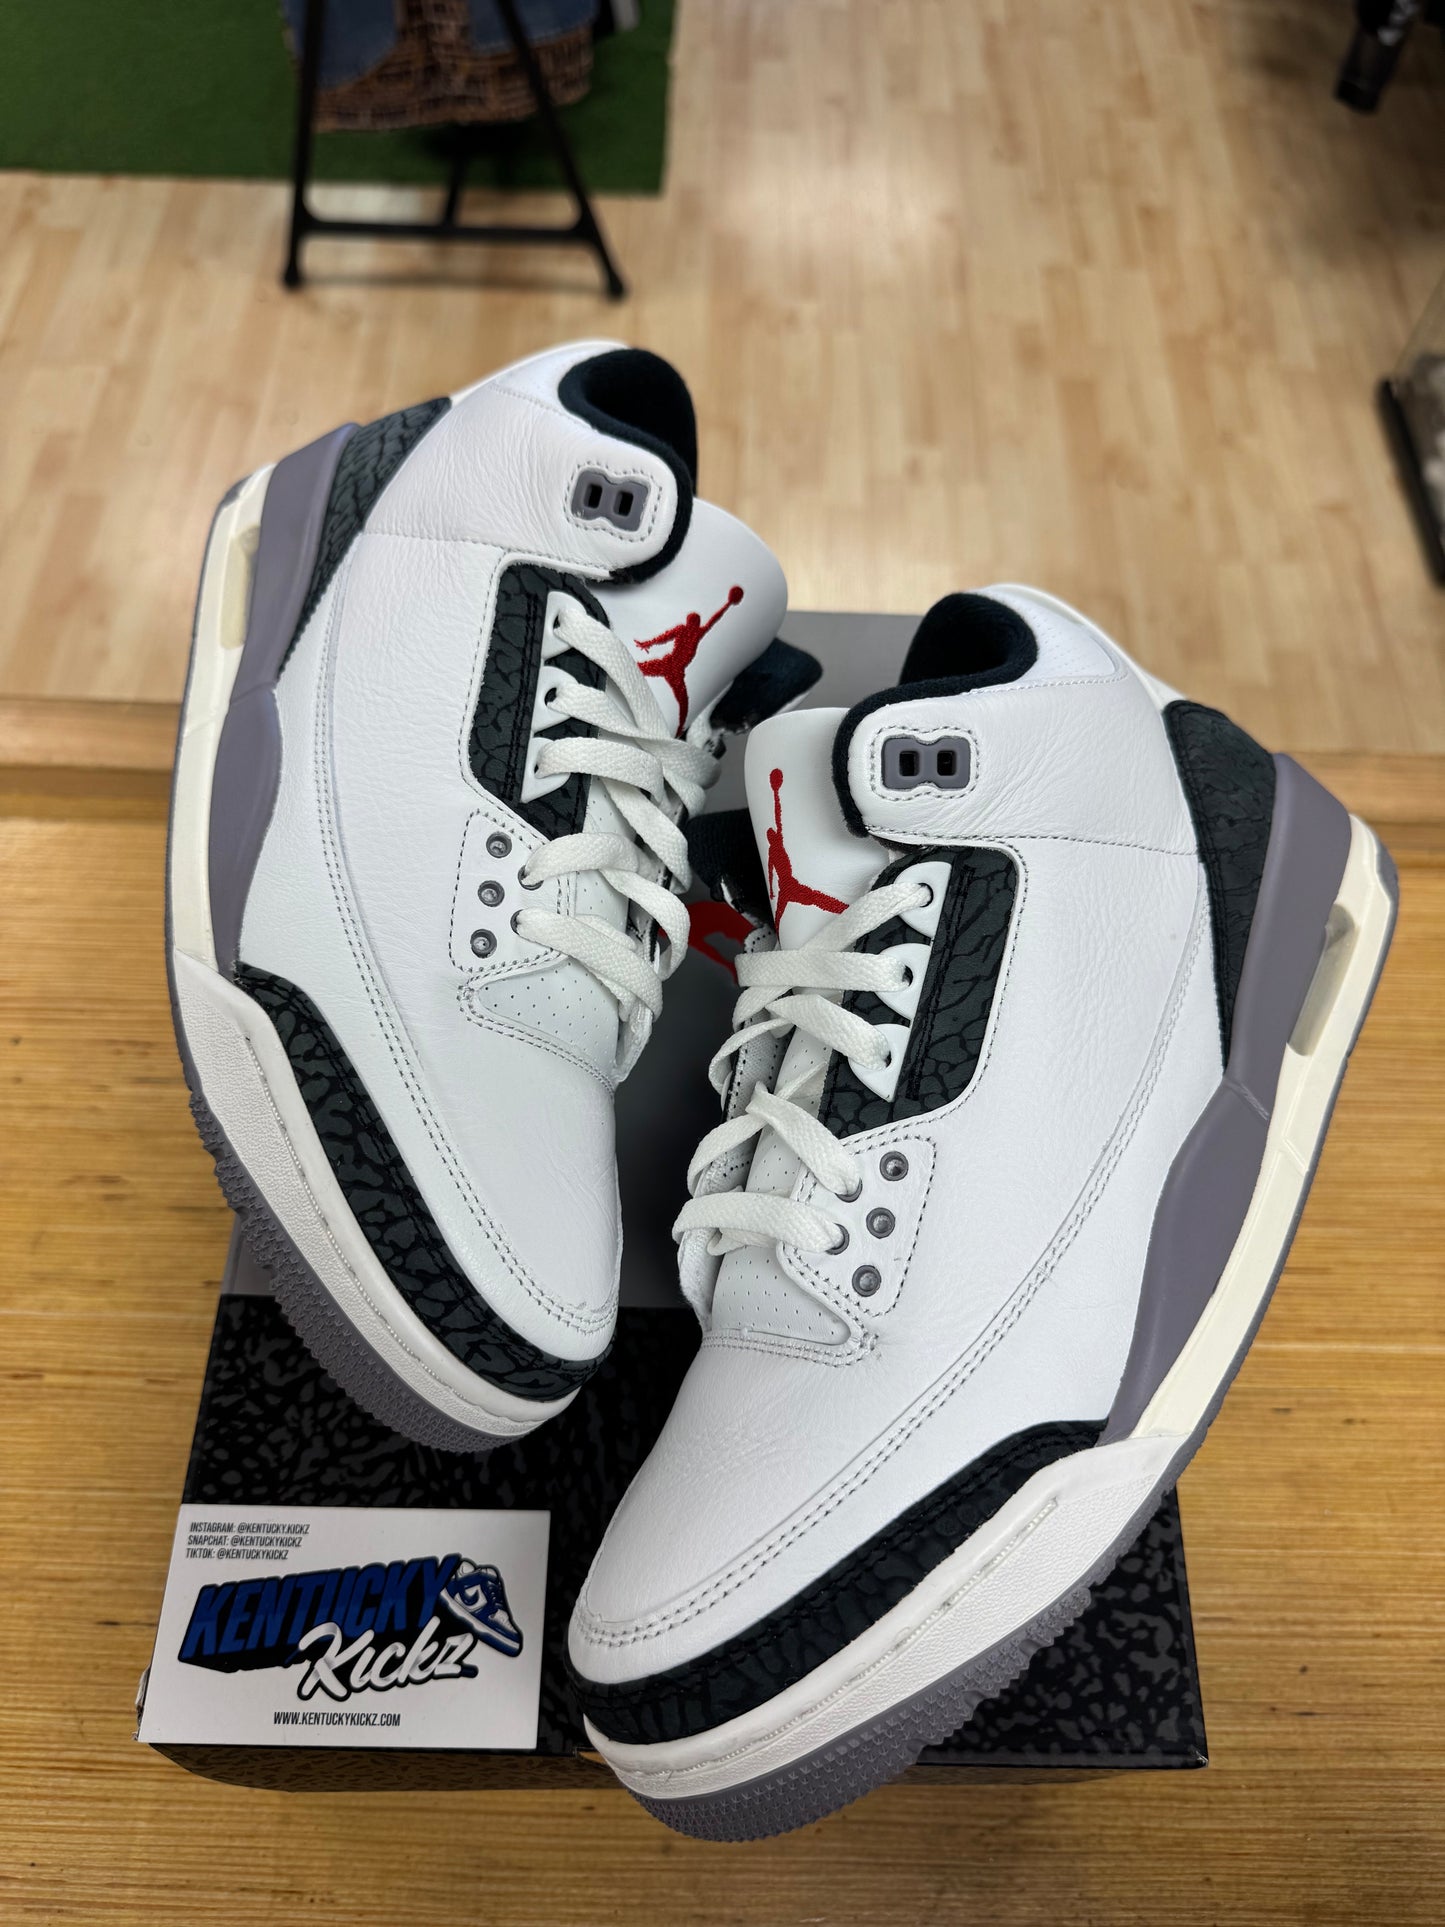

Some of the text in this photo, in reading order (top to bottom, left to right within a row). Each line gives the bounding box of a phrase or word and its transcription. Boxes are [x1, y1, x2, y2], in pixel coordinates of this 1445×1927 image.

[189, 1521, 236, 1533] INSTAGRAM:
[187, 1534, 303, 1547] SNAPCHAT: @KENTUCKYKICKZ
[186, 1547, 289, 1560] TIKTOK: @KENTUCKYKICKZ
[179, 1553, 462, 1660] KENTUCKY
[299, 1615, 474, 1698] Kickz
[273, 1711, 401, 1727] WWW.KENTUCKYKICKZ.COM
